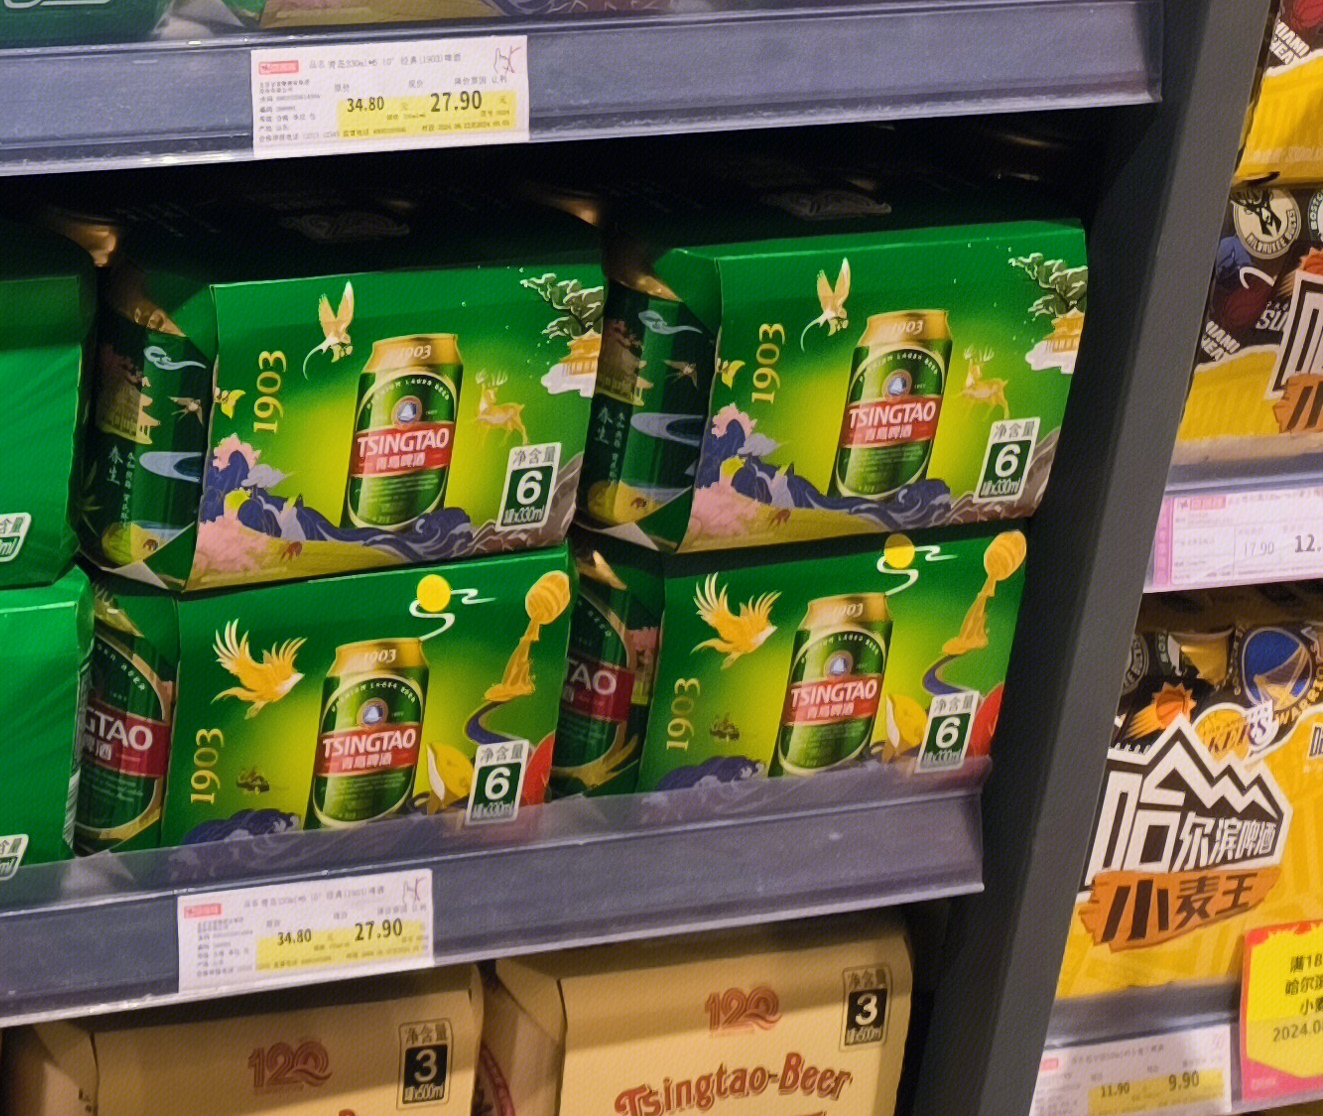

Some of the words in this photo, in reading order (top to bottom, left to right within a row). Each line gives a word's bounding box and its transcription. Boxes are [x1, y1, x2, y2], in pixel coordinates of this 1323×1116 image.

[347, 96, 384, 112] 34.80
[431, 91, 482, 112] 27.90
[751, 323, 785, 405] 1903
[253, 350, 287, 434] 1903
[849, 401, 936, 429] TSINGTAO
[357, 427, 450, 452] TSINGTAO
[1245, 541, 1274, 556] 17.90
[1295, 533, 1323, 553] 12.
[790, 679, 877, 709] TSINGTAO
[666, 678, 701, 752] 1903
[322, 729, 417, 758] TSINGTAO
[191, 728, 225, 805] 1903
[1101, 874, 1258, 943] 小麦王
[278, 928, 311, 946] 34.80
[355, 918, 402, 941] 27.90
[855, 993, 878, 1026] 3
[414, 1048, 440, 1082] 3
[1169, 1071, 1199, 1091] 9.90
